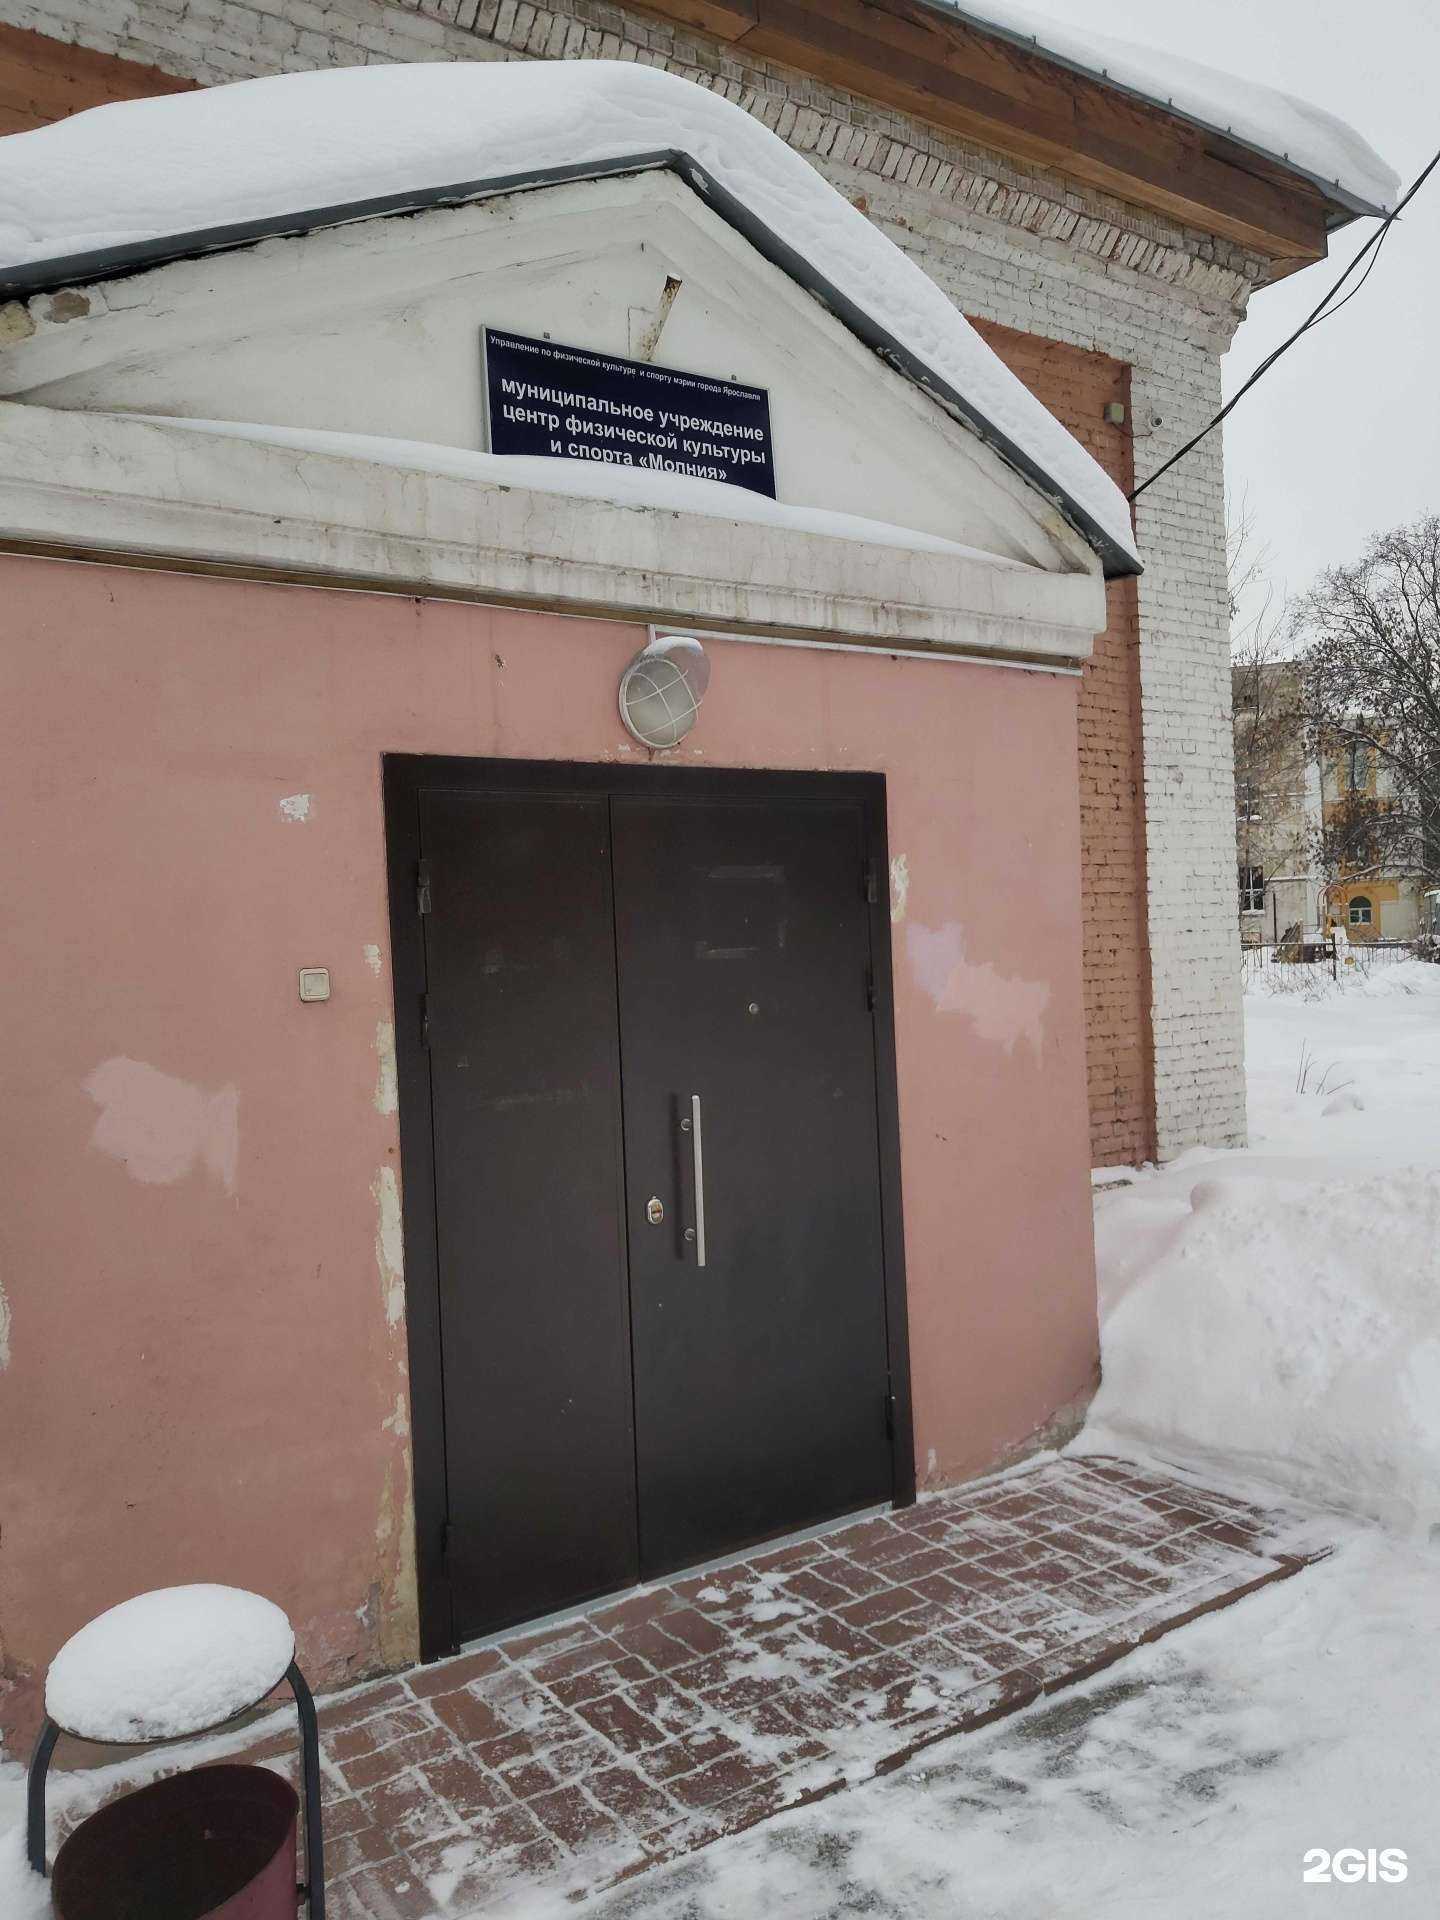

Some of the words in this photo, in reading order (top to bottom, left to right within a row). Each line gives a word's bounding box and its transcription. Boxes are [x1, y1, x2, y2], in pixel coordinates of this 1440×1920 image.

[490, 335, 539, 354] Управление
[541, 348, 551, 357] по
[553, 349, 600, 367] физической
[602, 361, 636, 375] культуре
[646, 371, 672, 384] спорту
[673, 376, 696, 387] мэрии
[697, 381, 722, 393] города
[723, 386, 761, 401] Ярославля
[503, 404, 560, 430] центр
[566, 414, 678, 450] физической
[683, 439, 766, 465] культуры
[659, 410, 764, 441] учреждение
[550, 439, 562, 454] и
[568, 443, 633, 466] спорта
[638, 452, 727, 480] «Молния»
